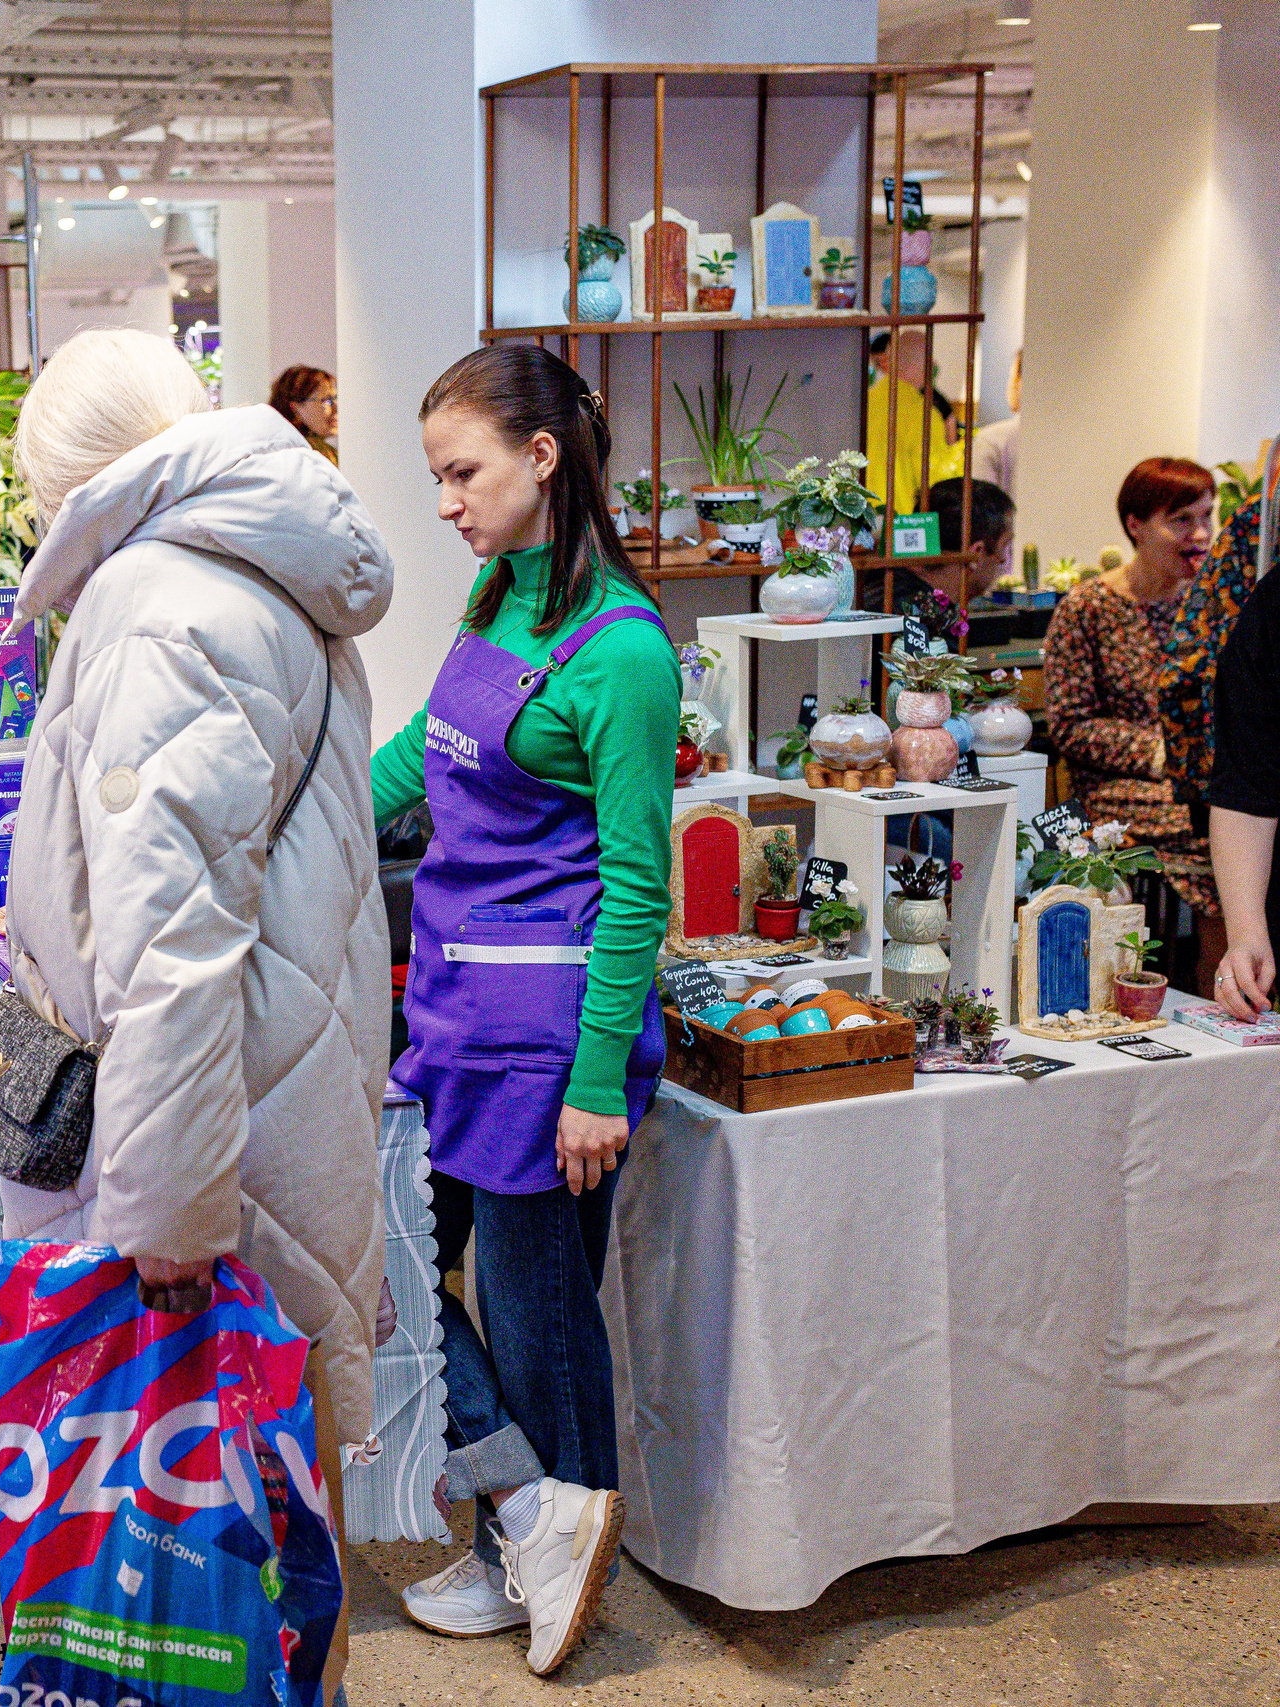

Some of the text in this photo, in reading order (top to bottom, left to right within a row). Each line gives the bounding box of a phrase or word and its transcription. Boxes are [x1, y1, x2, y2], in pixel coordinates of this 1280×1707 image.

[1035, 805, 1071, 827] БЛЕСК
[809, 869, 834, 885] Rosa
[812, 860, 834, 875] Villa
[684, 975, 710, 987] Сони
[160, 1534, 207, 1570] банк
[116, 1630, 233, 1664] банковская
